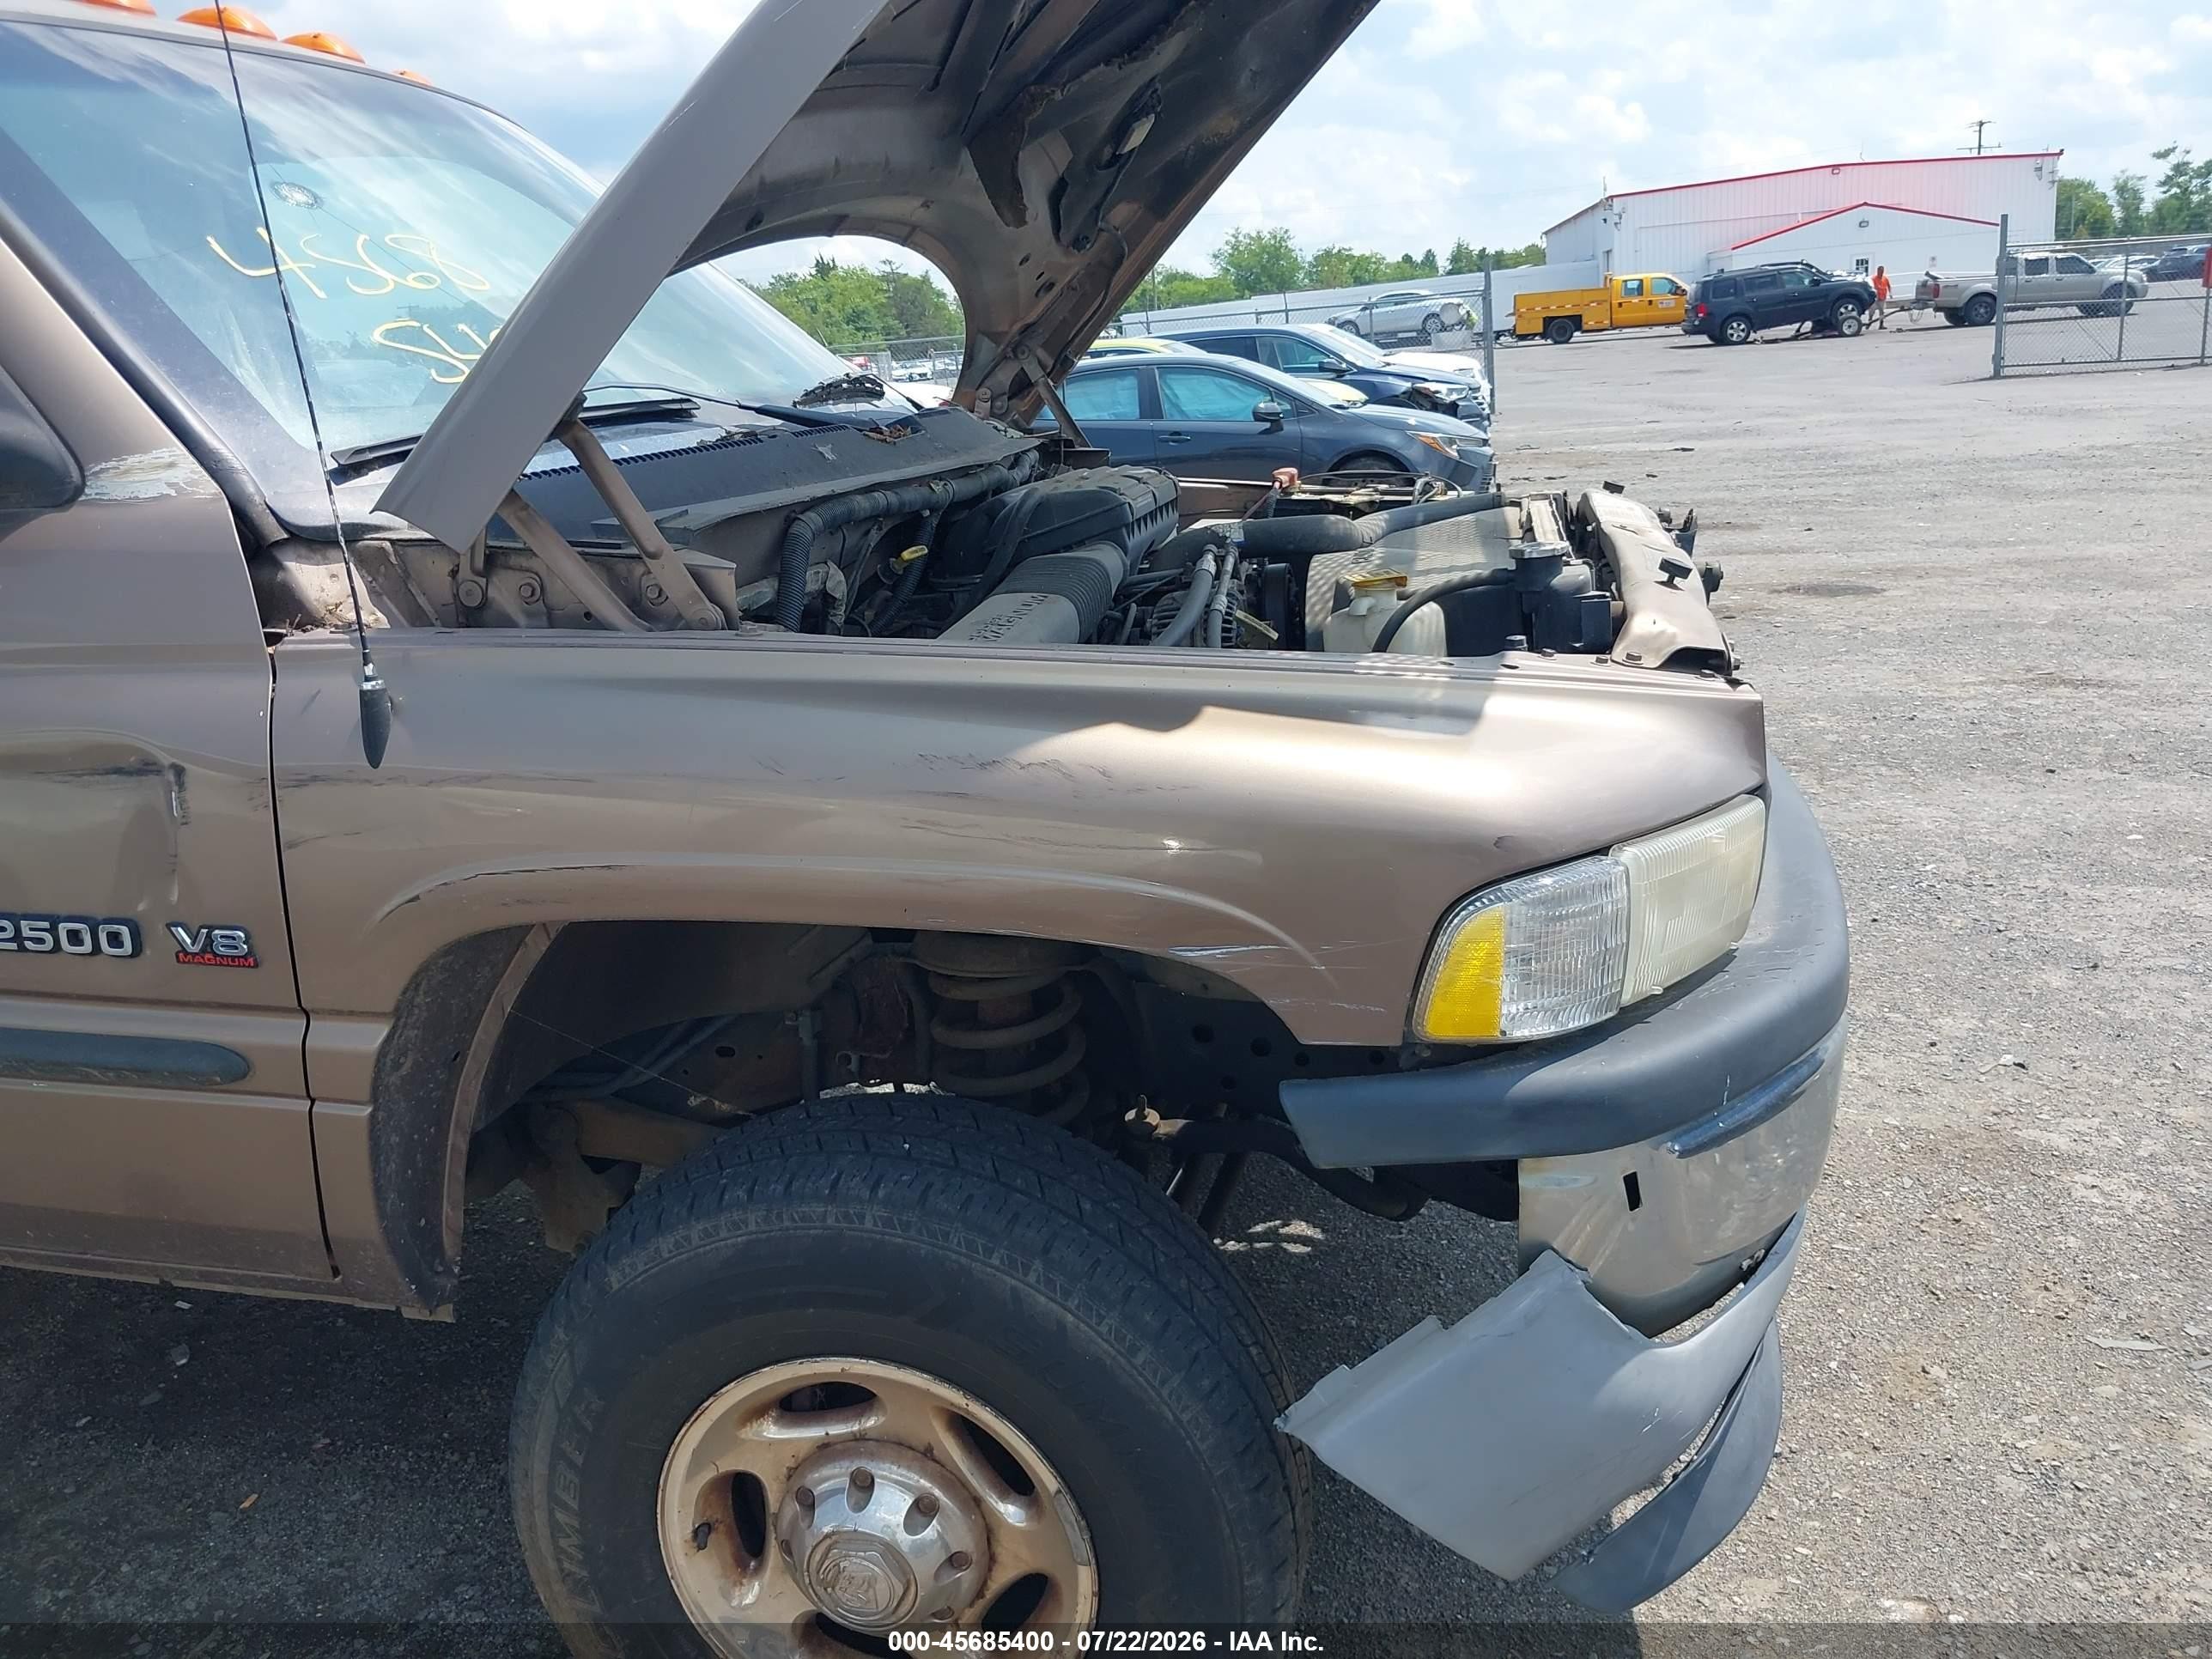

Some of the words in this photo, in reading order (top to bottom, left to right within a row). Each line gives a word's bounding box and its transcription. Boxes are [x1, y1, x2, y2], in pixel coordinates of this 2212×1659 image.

[206, 227, 491, 299] 4568
[0, 919, 133, 957] 2500
[170, 927, 248, 956] V8
[178, 952, 255, 967] MAGNUM
